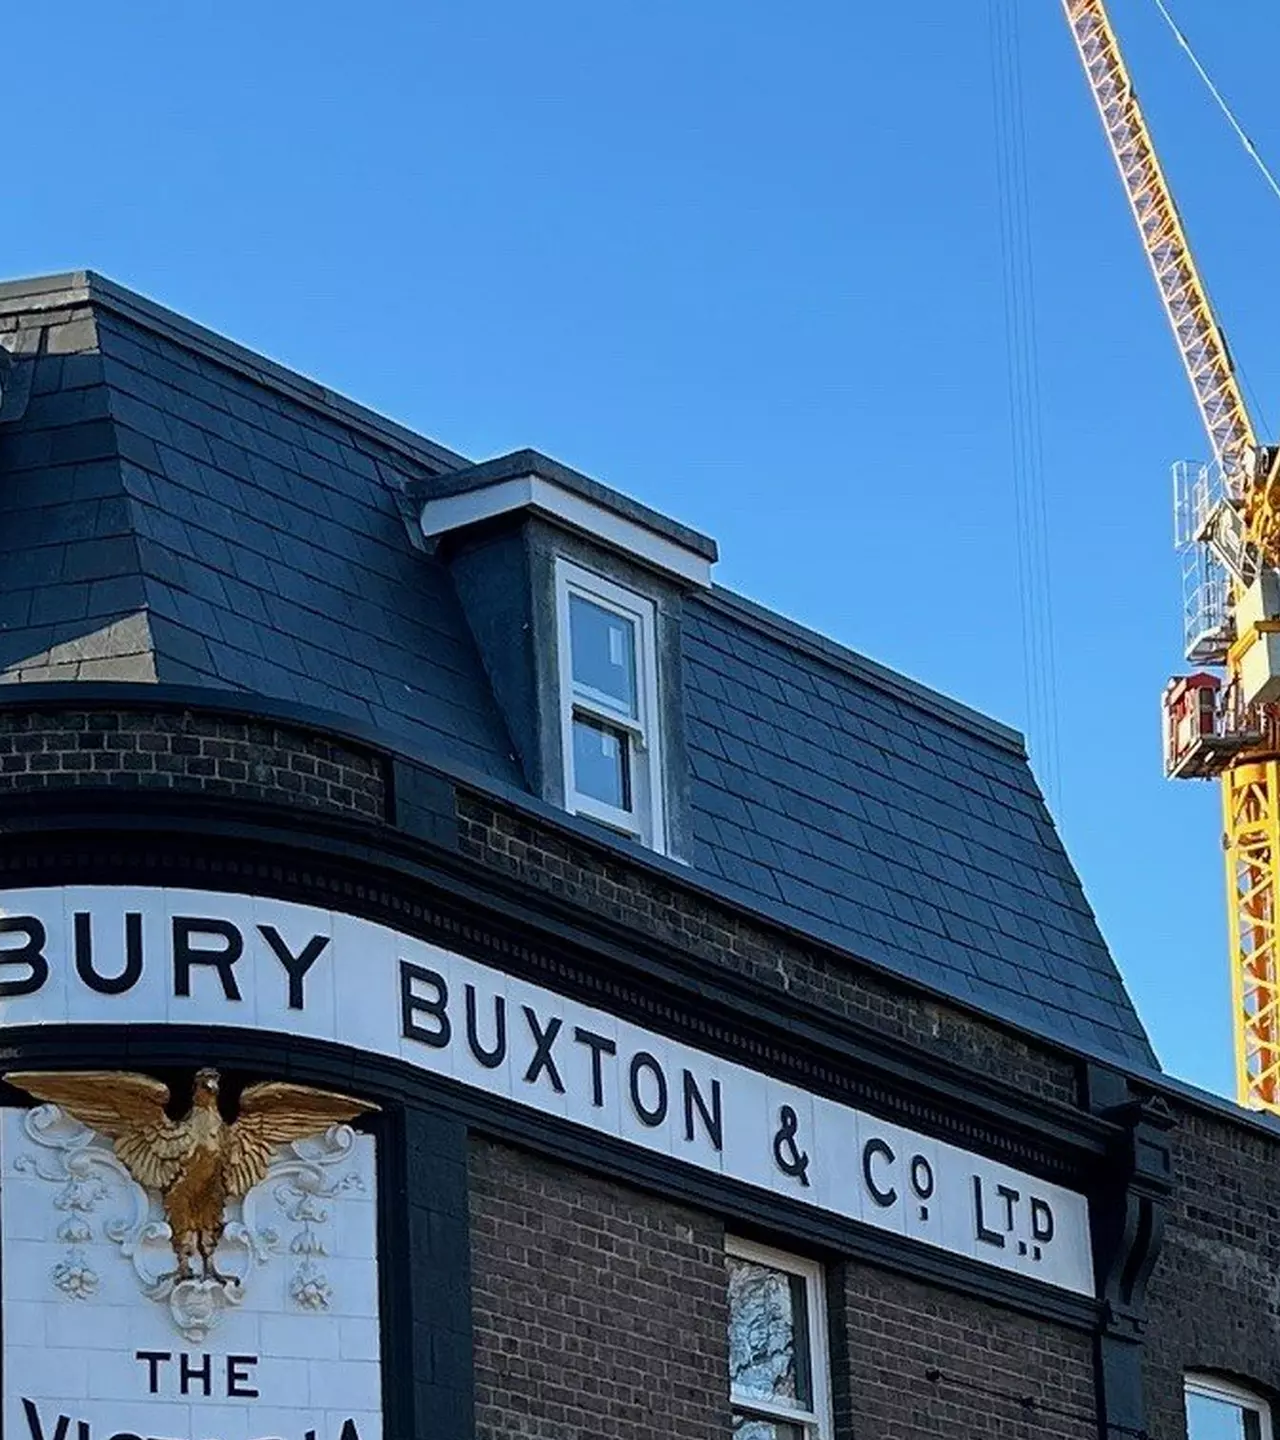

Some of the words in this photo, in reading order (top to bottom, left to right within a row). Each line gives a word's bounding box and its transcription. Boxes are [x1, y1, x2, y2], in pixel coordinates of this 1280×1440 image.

[399, 960, 722, 1152] BUXTON
[773, 1104, 809, 1187] &
[136, 1351, 259, 1398] THE
